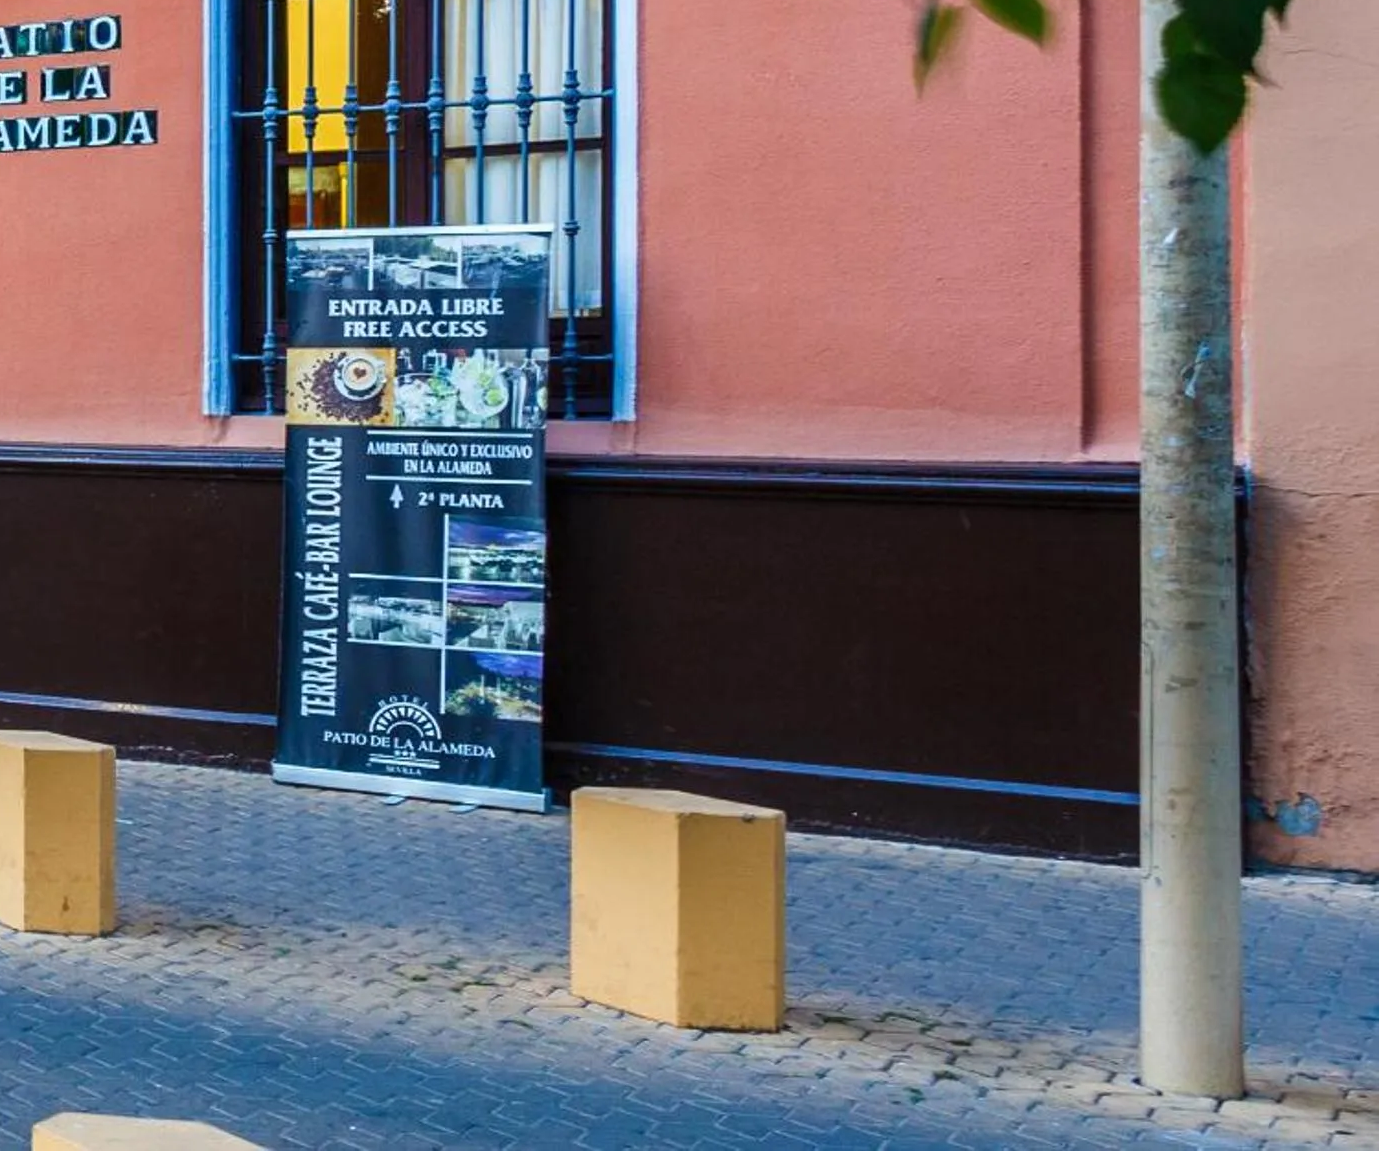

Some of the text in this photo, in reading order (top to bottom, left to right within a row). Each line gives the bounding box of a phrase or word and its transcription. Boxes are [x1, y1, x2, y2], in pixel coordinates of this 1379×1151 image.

[42, 66, 107, 101] LA
[328, 297, 504, 317] ENTRADA LIBRE
[343, 320, 488, 338] FREE ACCESS
[367, 439, 533, 460] AMBIENTE ÚNICO Y EXCLUSIVO
[404, 459, 493, 476] EN LA ALAMEDA
[439, 493, 505, 509] PLANTA
[295, 436, 342, 717] TERRAZA CAFÉ-BAR LOUNGE
[323, 730, 496, 759] PATIO DE LA ALAMEDA
